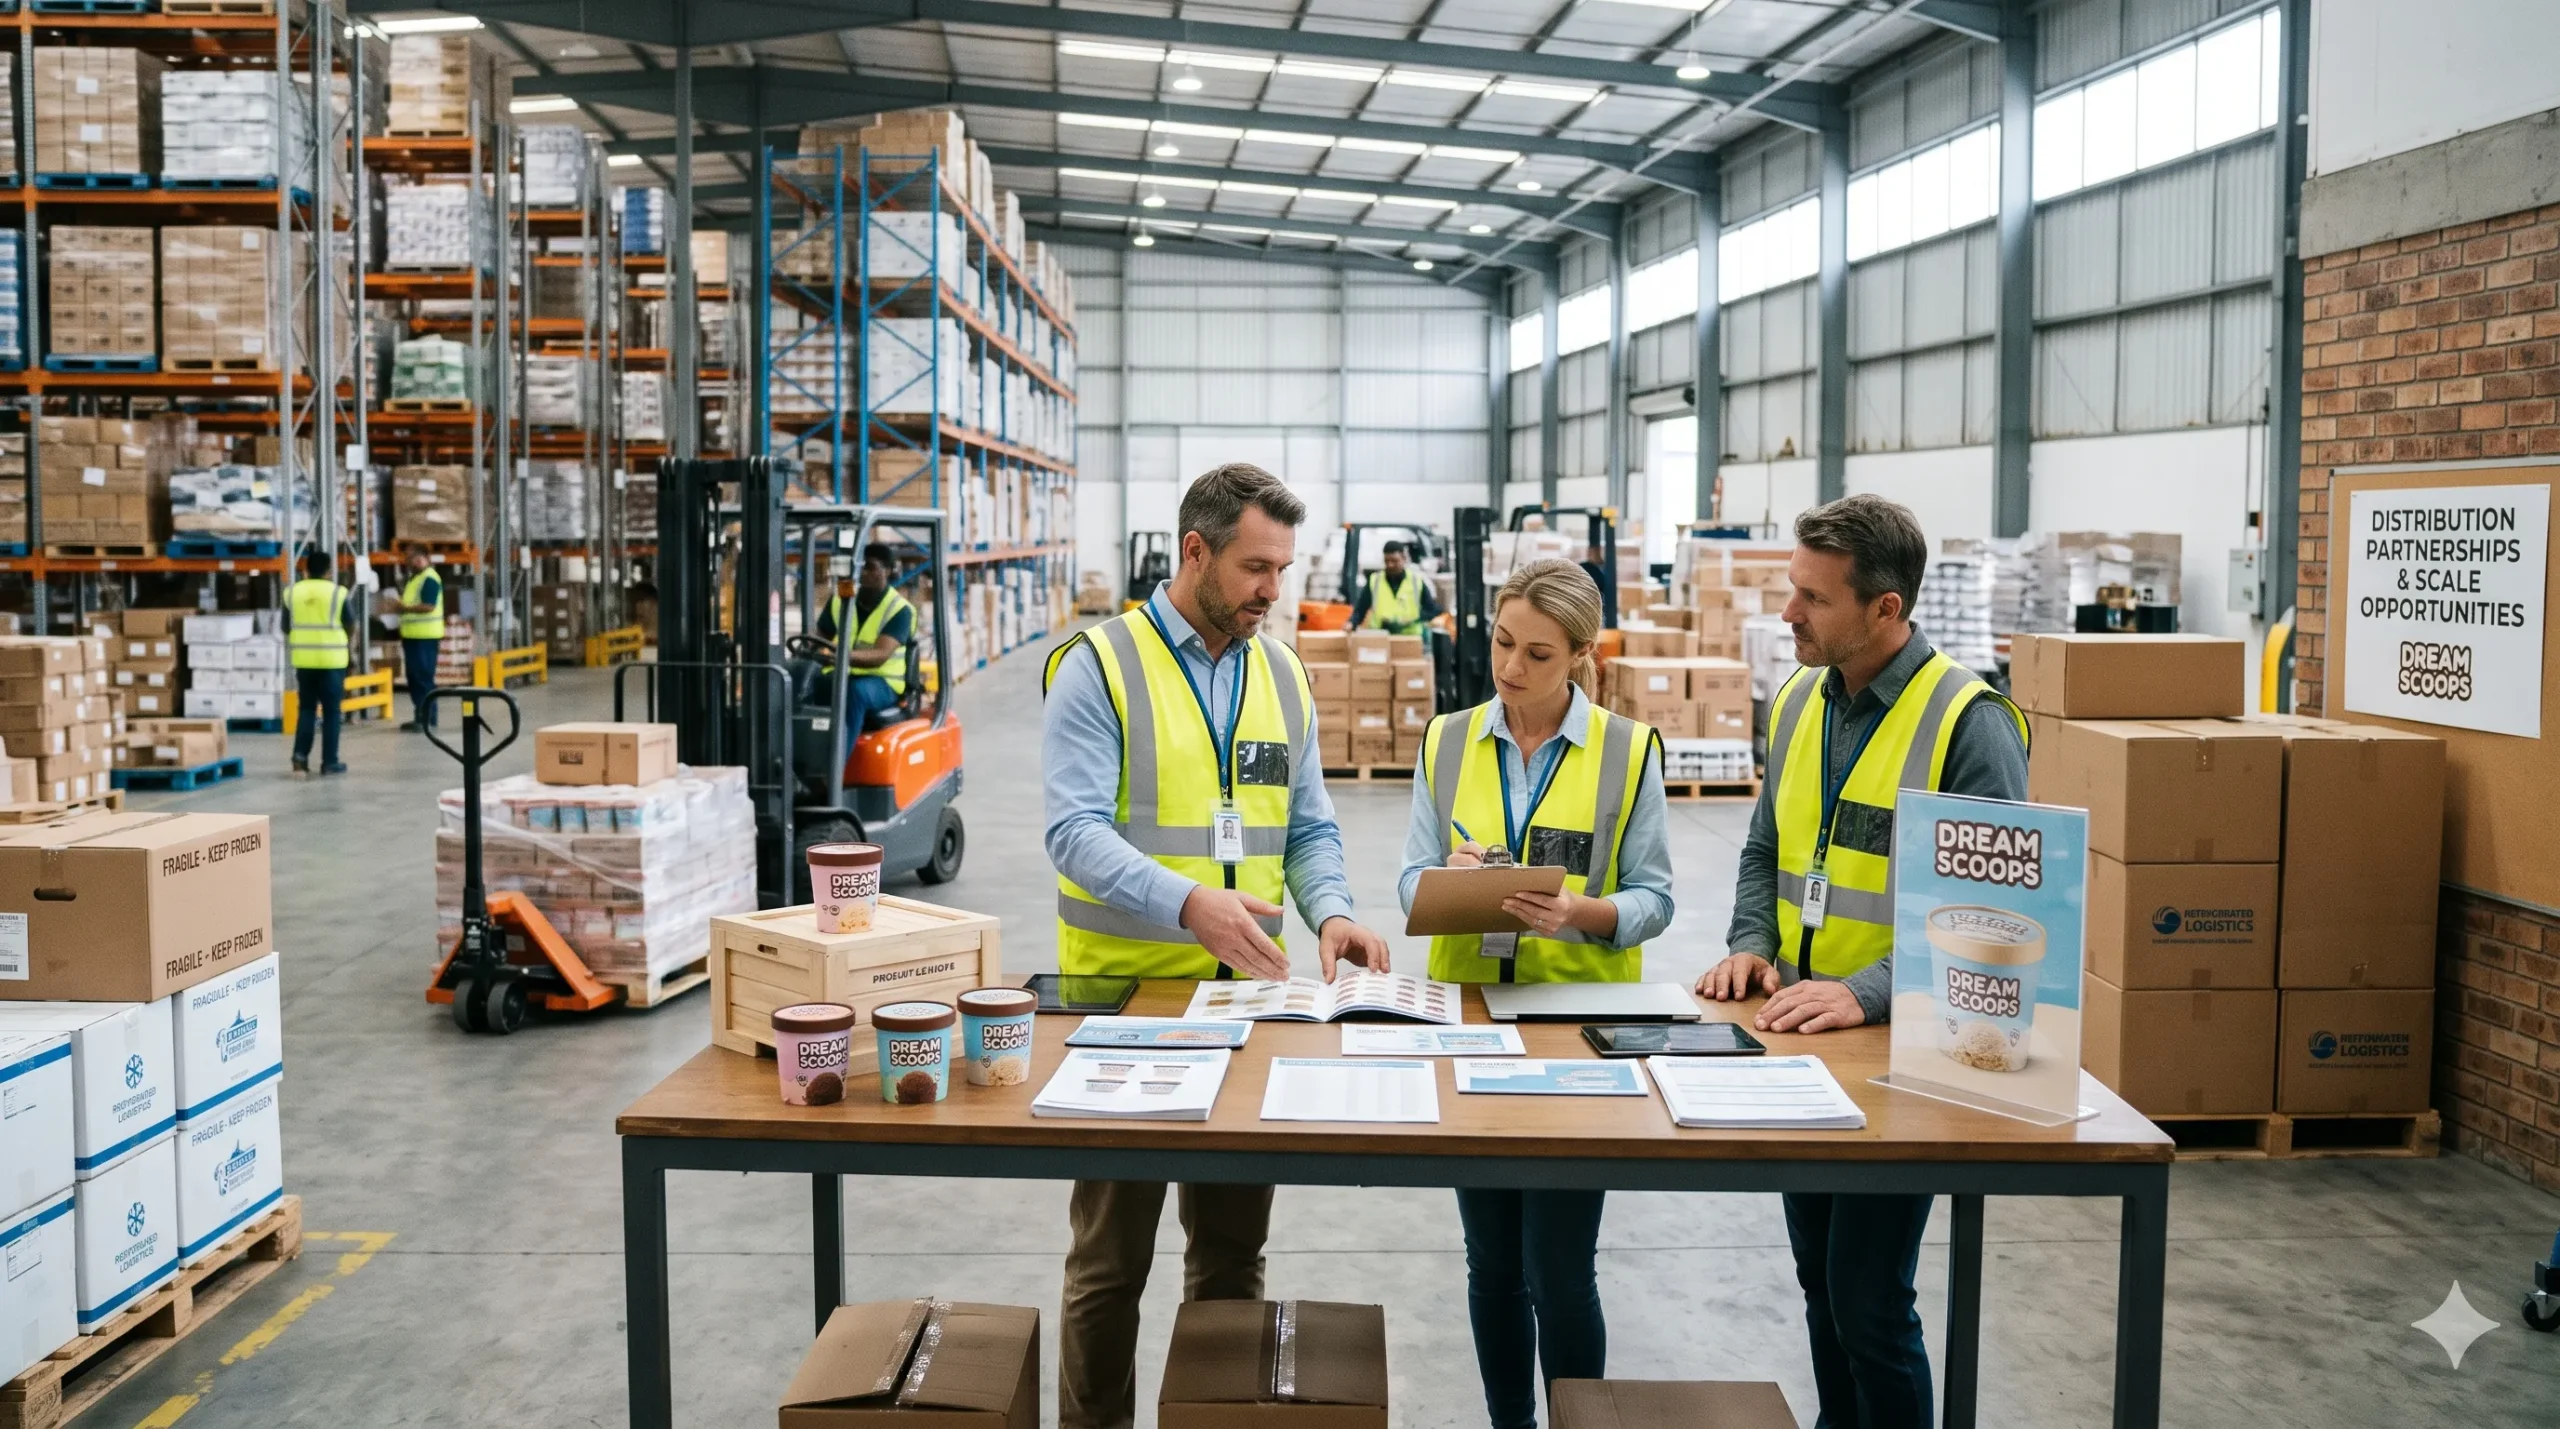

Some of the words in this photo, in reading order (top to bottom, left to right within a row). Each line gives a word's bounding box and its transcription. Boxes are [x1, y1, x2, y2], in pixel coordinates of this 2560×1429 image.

[2372, 507, 2515, 531] DISTRIBUTION
[2366, 539, 2520, 562] PARTNERSHIPS
[2397, 568, 2409, 591] &
[2415, 568, 2481, 593] SCALE
[2360, 596, 2524, 627] OPPORTUNITIES
[2400, 641, 2471, 674] DREAM
[2398, 668, 2471, 701] SCOOPS
[1936, 820, 2041, 861] DREAM
[163, 850, 200, 877] FRAGILE
[208, 842, 229, 864] KEEP
[231, 833, 261, 857] FROZEN
[831, 870, 877, 887] DREAM
[1935, 850, 2041, 889] SCOOPS
[2185, 919, 2254, 932] LOGISTICS
[166, 950, 203, 980] FRAGILE
[211, 939, 233, 962] KEEP
[234, 927, 263, 953] FROZEN
[1948, 967, 2019, 999] DREAM
[1948, 988, 2020, 1017] SCOOPS
[983, 1021, 1029, 1038] DREAM
[798, 1037, 848, 1056] DREAM
[890, 1037, 941, 1054] DREAM
[2340, 1044, 2409, 1057] LOGISTICS
[799, 1051, 848, 1068] SCOOPS
[890, 1051, 941, 1066] SCOOPS
